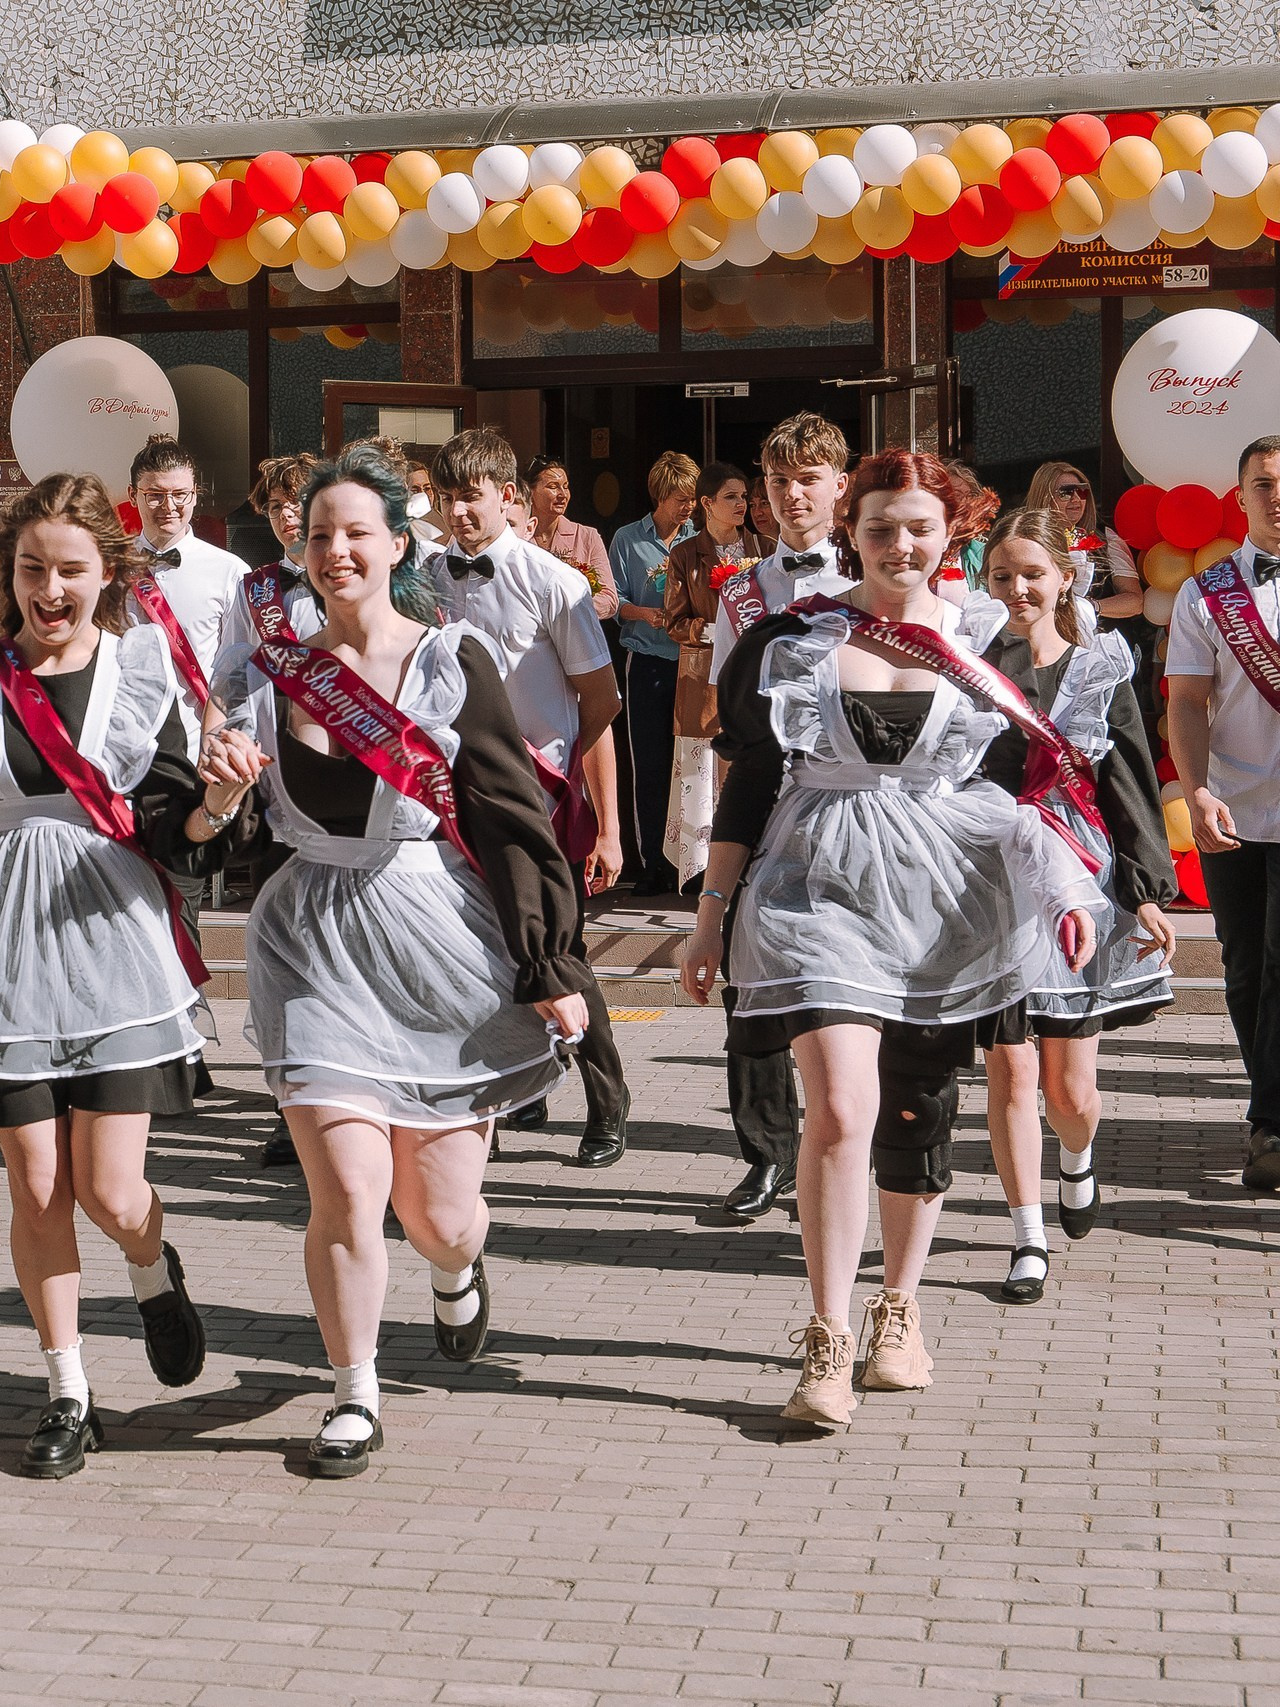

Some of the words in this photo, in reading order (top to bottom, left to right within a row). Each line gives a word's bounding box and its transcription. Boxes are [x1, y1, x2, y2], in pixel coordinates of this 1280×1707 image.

[1080, 253, 1173, 268] КОМИССИЯ
[1007, 276, 1099, 290] ИЗБИРАТЕЛЬНОГО
[1102, 274, 1148, 288] УЧАСТКА
[1147, 367, 1243, 396] Выпуск
[1166, 399, 1229, 415] 2024
[1215, 611, 1231, 631] МАОУ
[1235, 646, 1249, 664] СОШ
[301, 691, 327, 713] МАОУ
[302, 657, 424, 770] Выпускница
